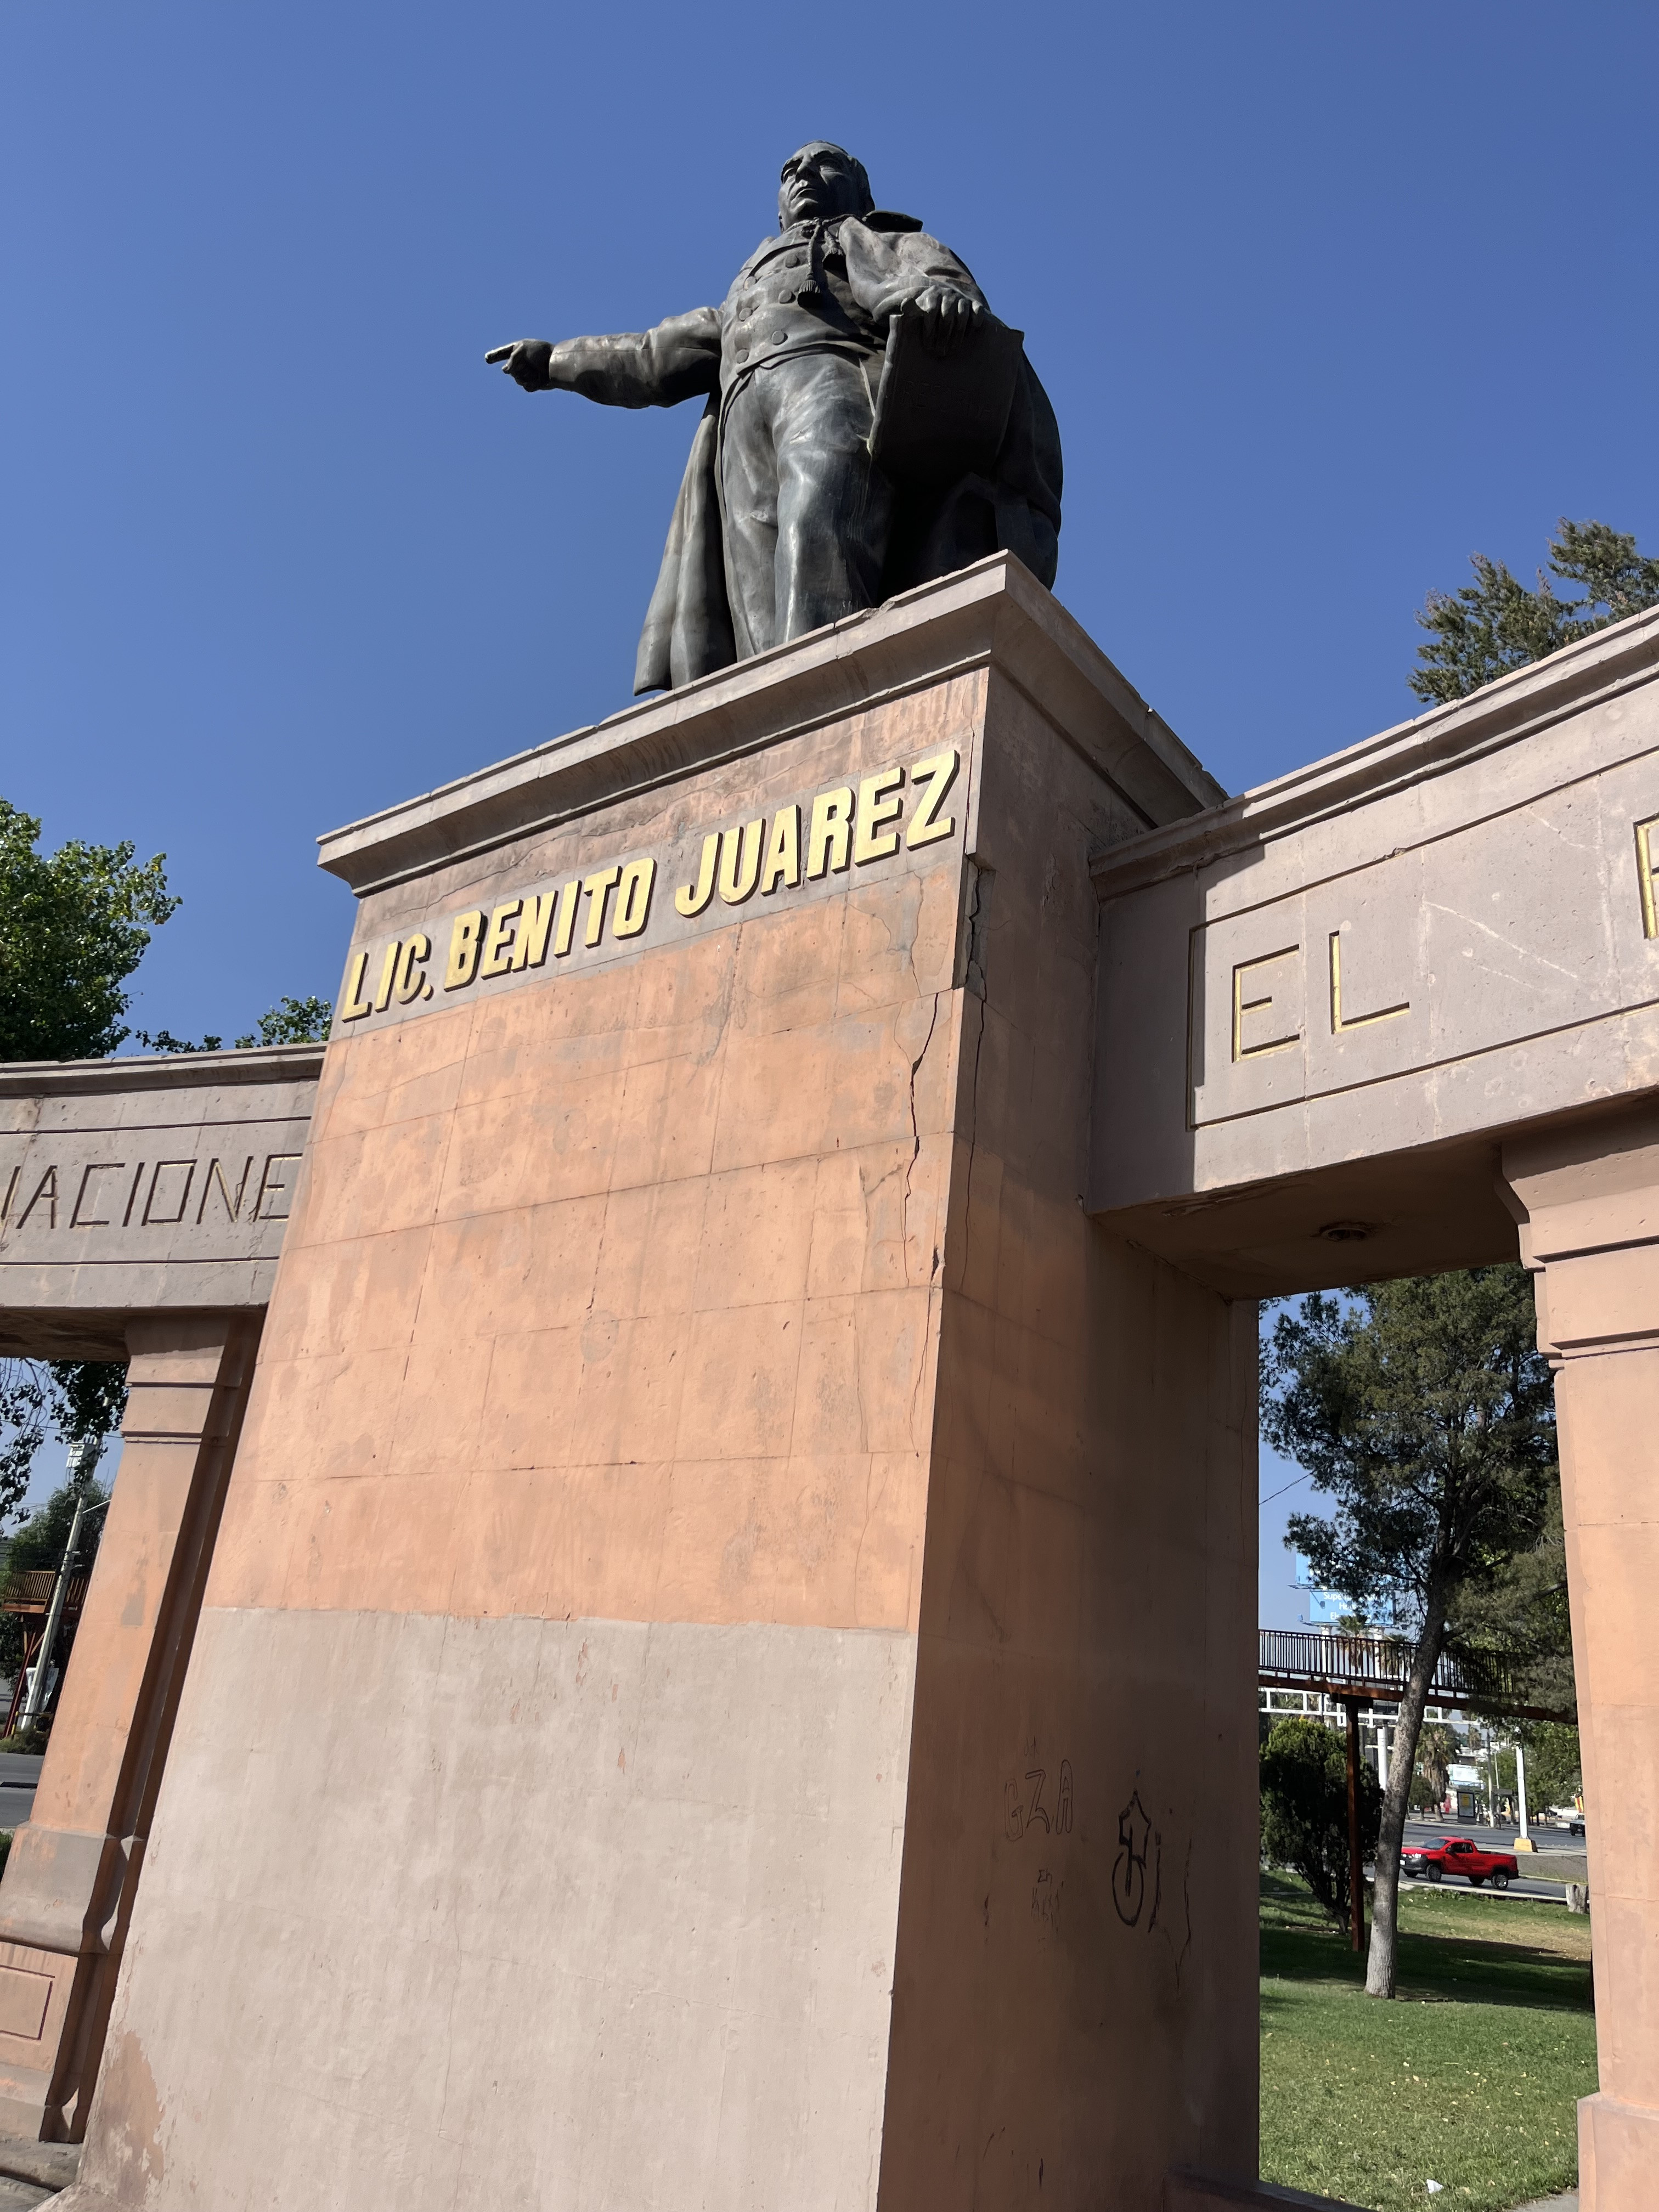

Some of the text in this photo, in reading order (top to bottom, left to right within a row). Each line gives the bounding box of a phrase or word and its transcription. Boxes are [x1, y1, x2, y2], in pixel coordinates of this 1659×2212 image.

[342, 750, 960, 1023] LIC. BENITO JUAREZ
[1232, 930, 1410, 1063] EL
